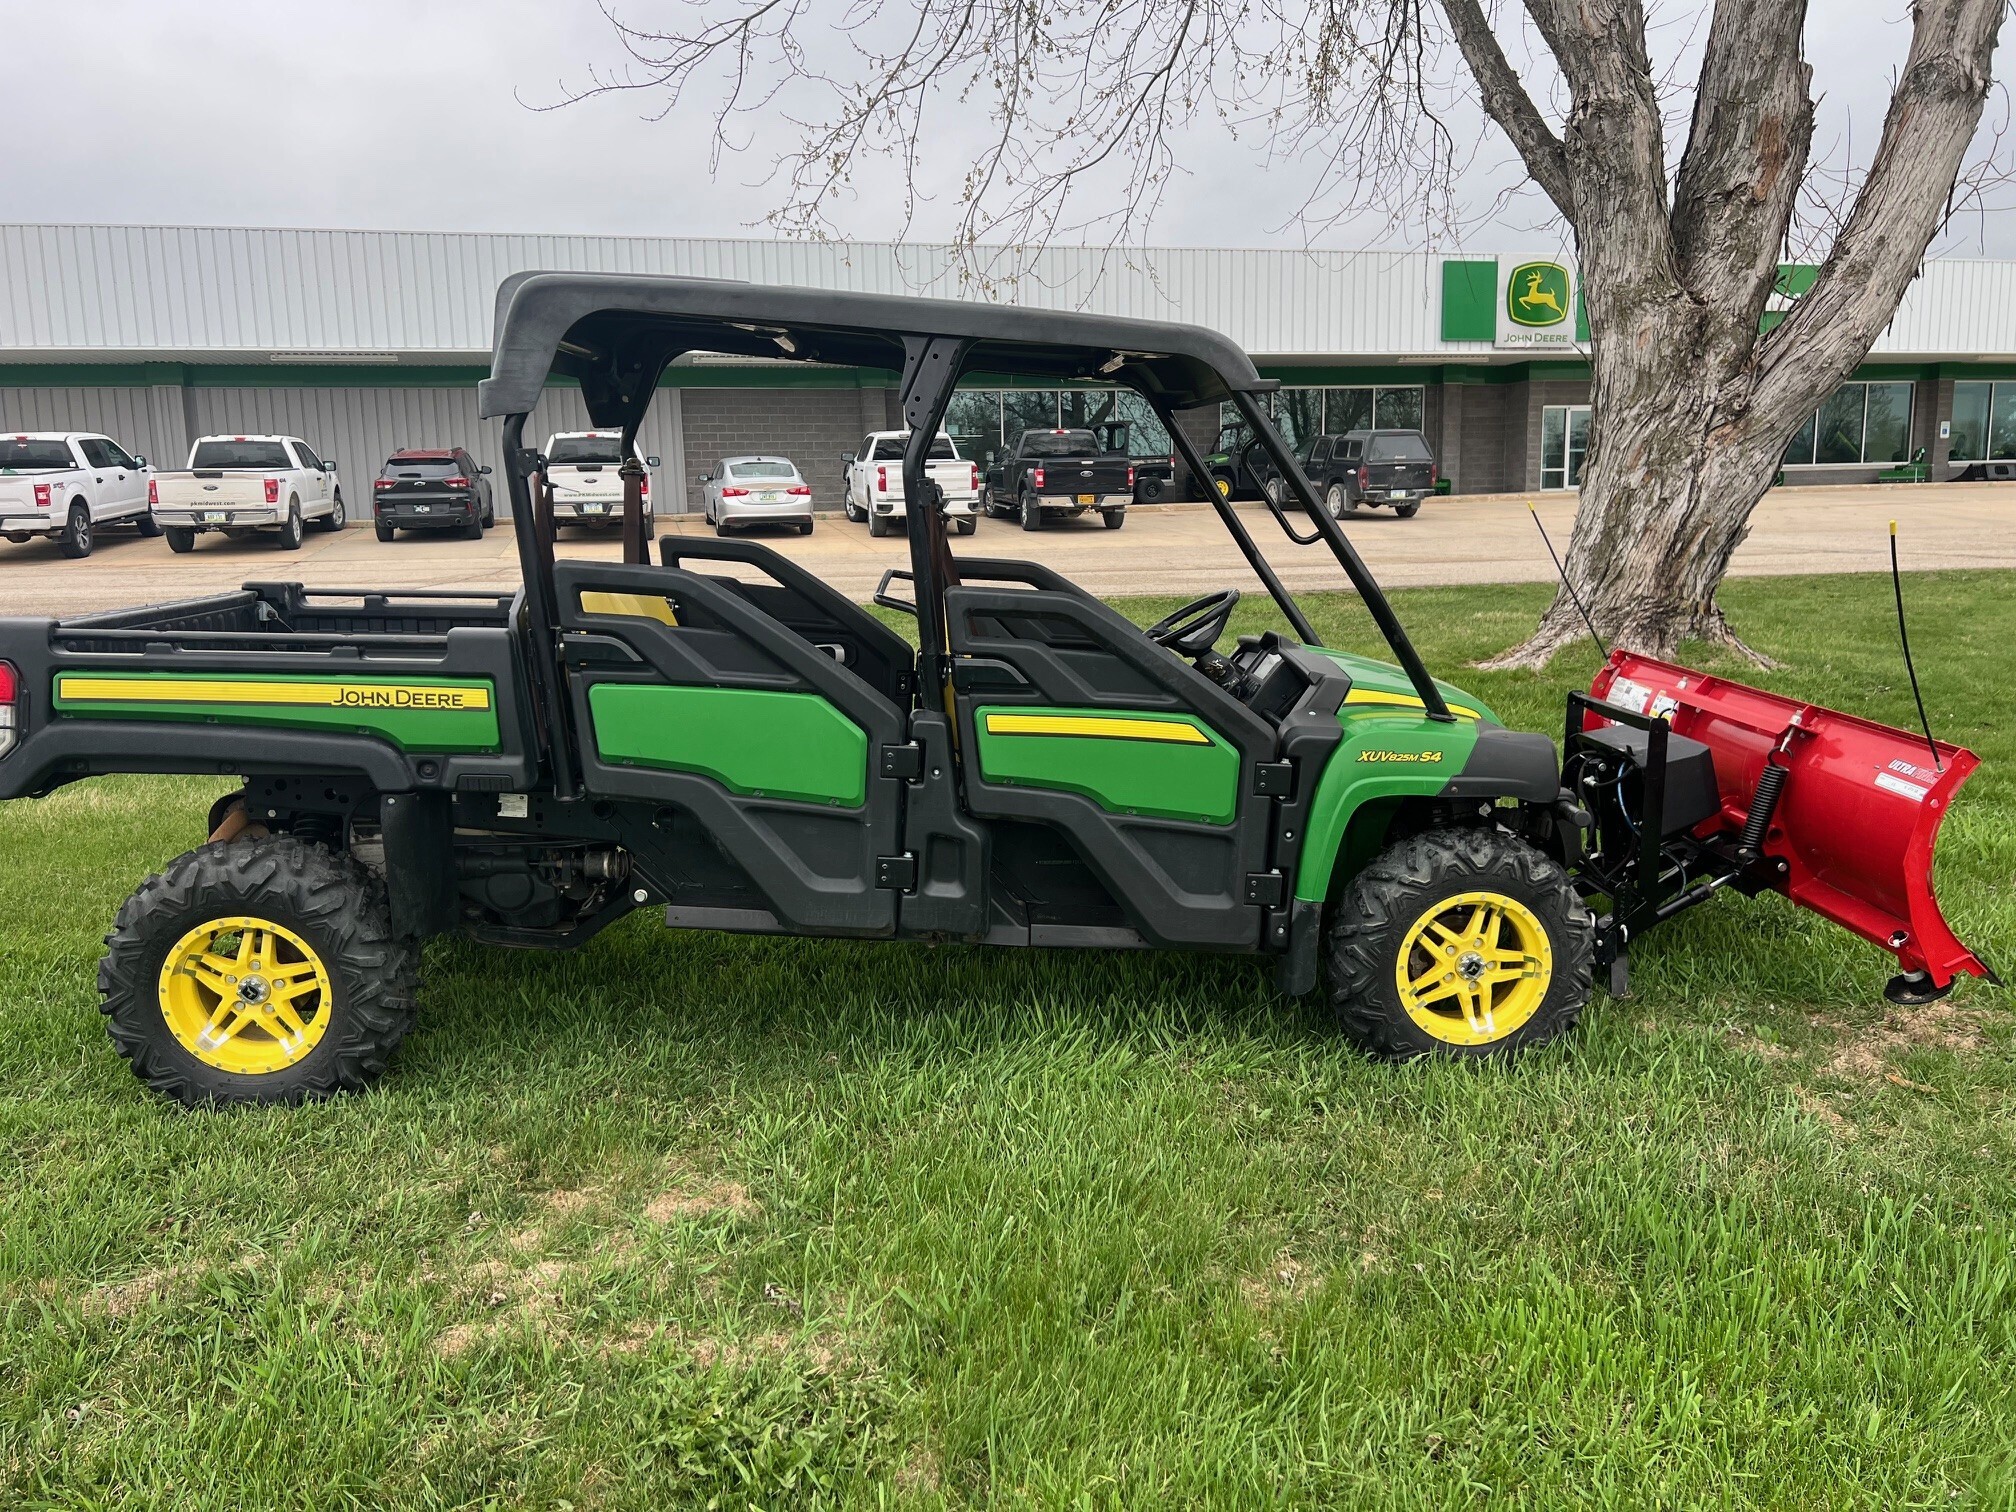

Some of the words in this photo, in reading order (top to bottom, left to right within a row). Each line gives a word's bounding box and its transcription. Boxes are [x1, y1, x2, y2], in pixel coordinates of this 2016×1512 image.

[1504, 333, 1532, 342] JOHN
[1534, 333, 1568, 343] DEERE
[333, 688, 390, 705] JOHN
[395, 689, 464, 707] DEERE
[1357, 750, 1420, 763] XUV825M
[1419, 750, 1443, 763] S4
